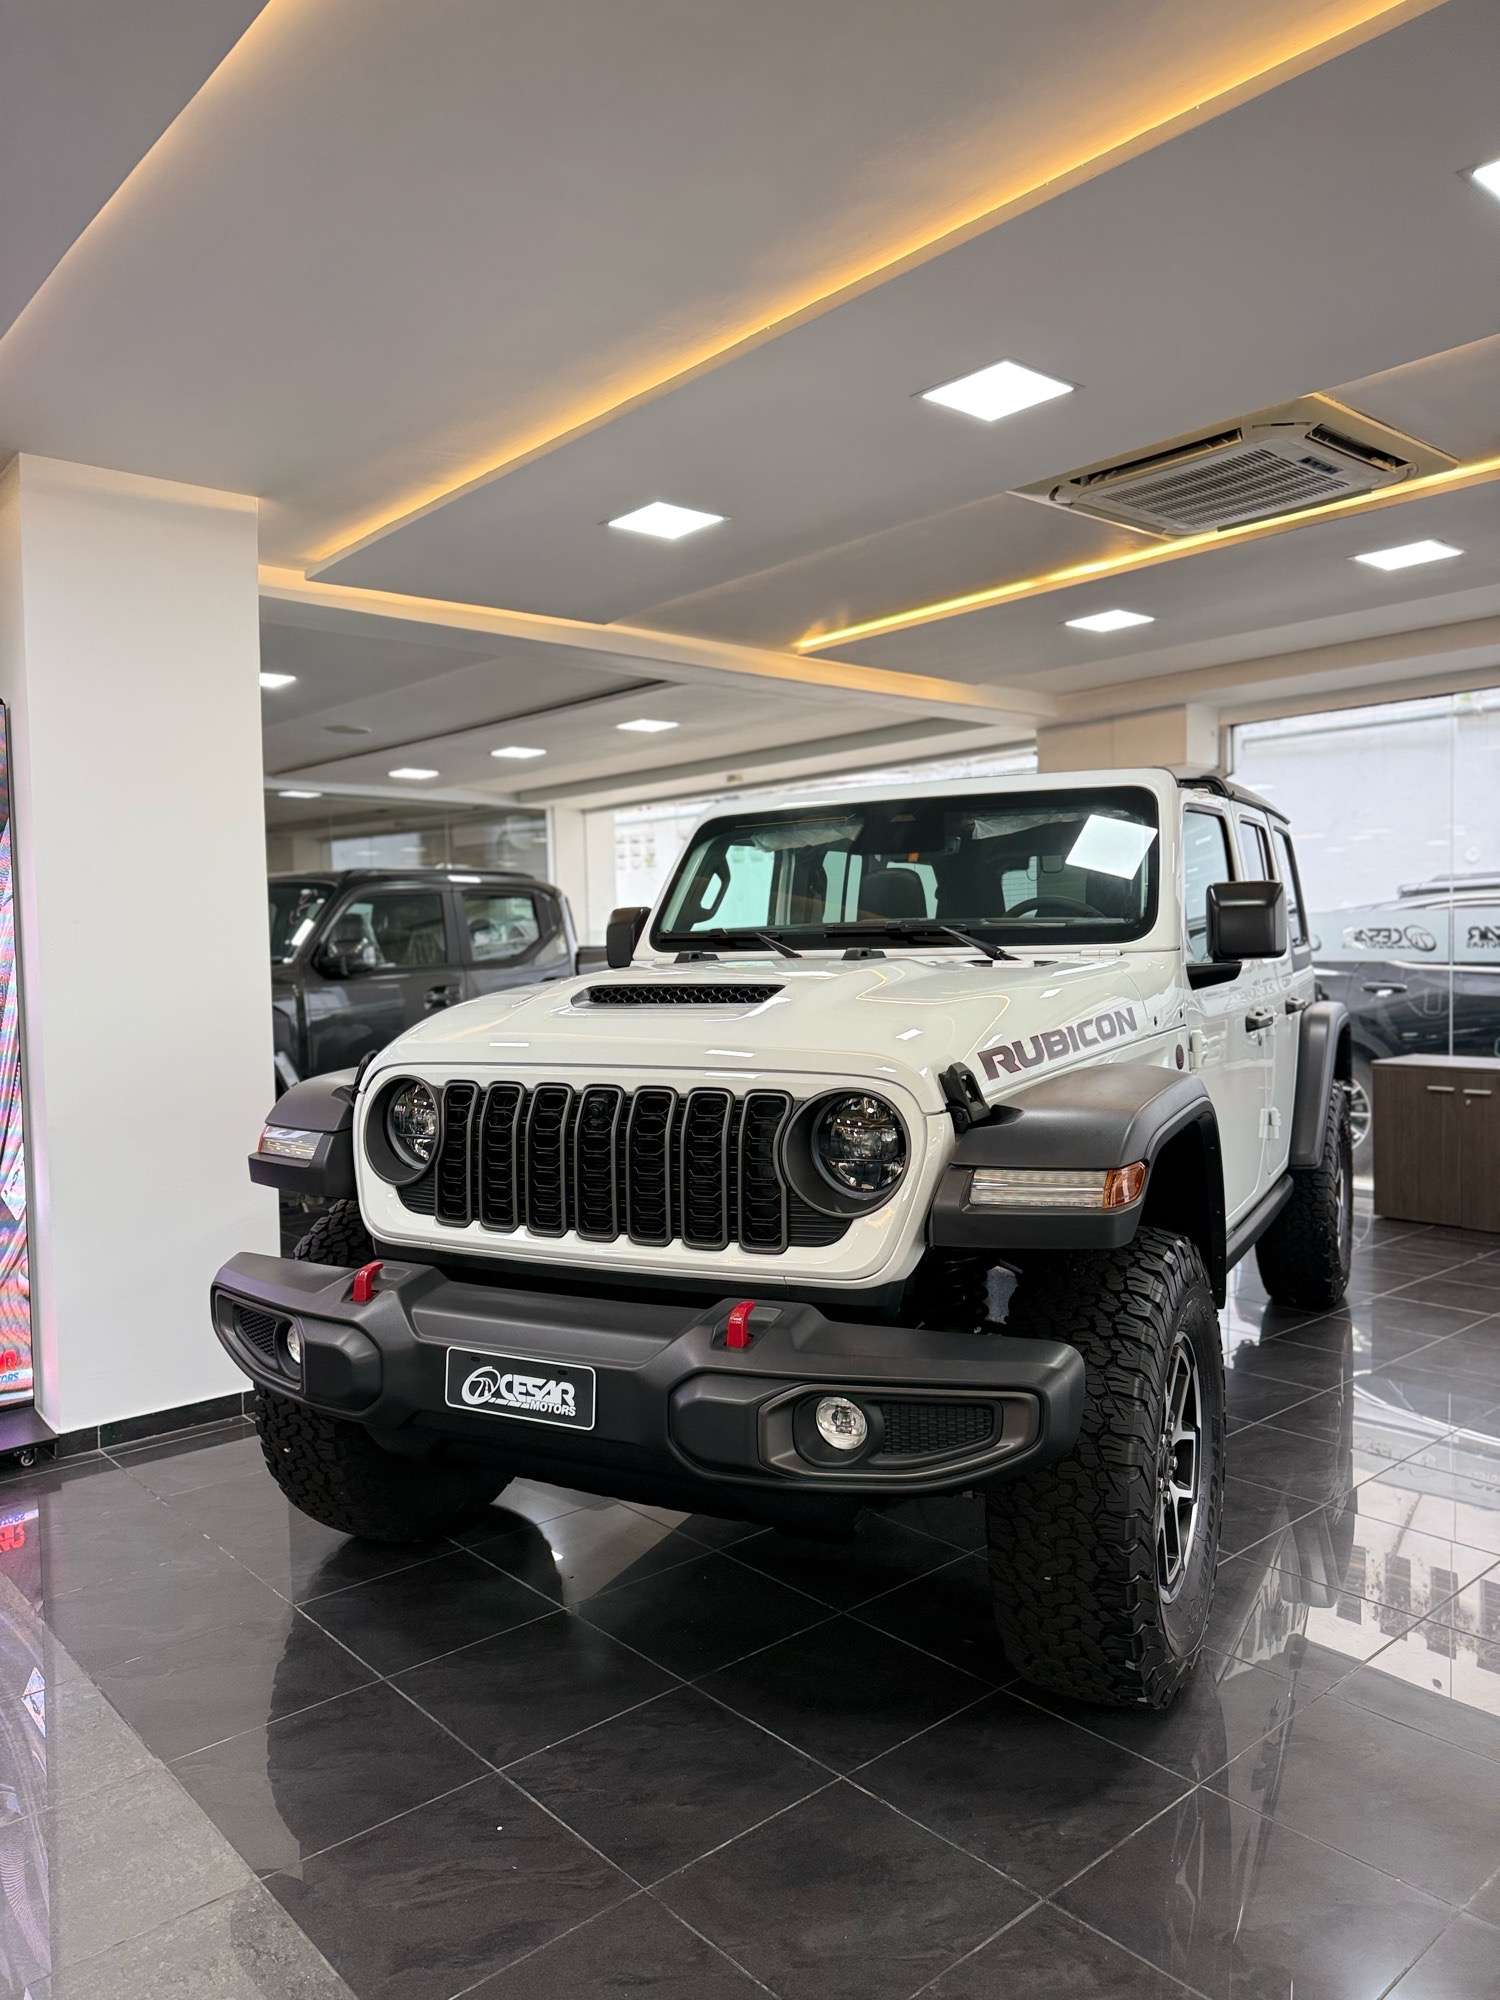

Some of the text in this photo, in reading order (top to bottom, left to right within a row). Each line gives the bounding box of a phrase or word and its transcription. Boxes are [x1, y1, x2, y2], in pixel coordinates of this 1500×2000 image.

[977, 1007, 1138, 1081] RUBICON
[500, 1374, 575, 1406] CESAR
[530, 1400, 577, 1416] MOTORS
